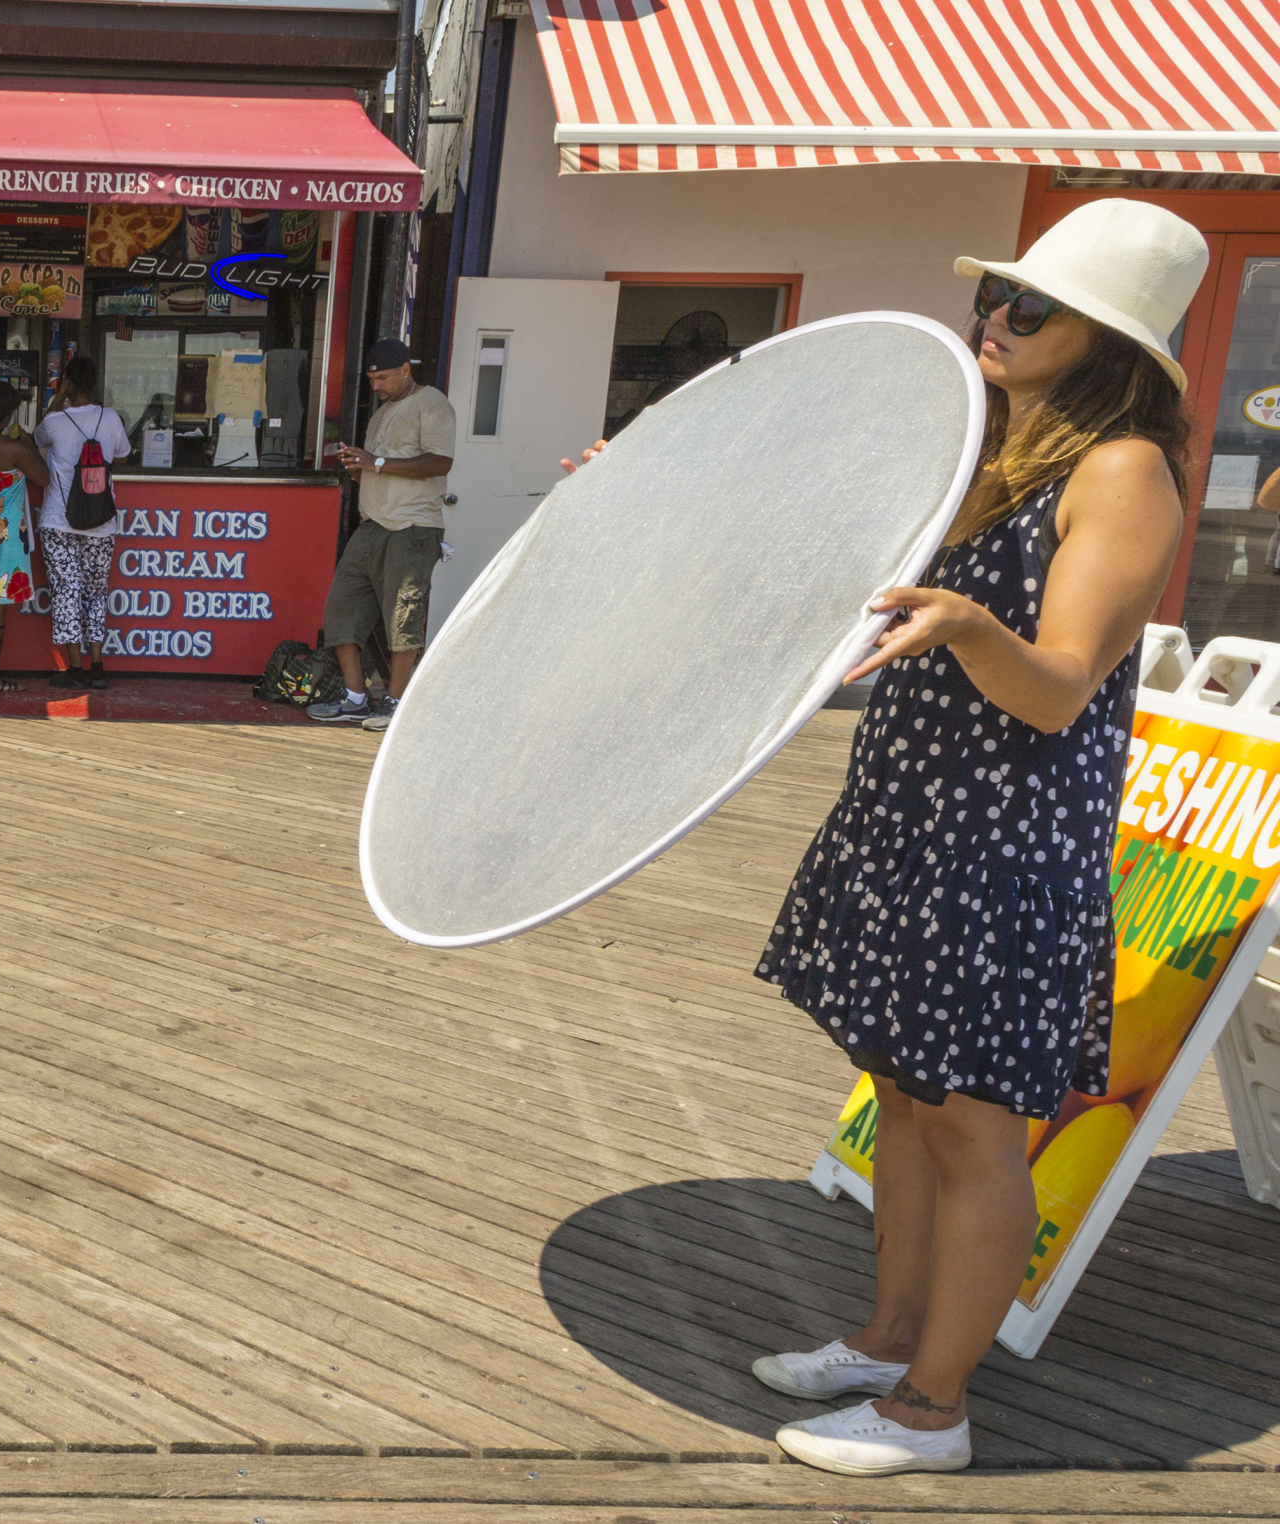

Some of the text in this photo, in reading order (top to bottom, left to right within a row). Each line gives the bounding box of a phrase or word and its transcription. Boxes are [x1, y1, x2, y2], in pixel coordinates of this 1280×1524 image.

[84, 171, 150, 195] FRIES
[175, 175, 282, 201] CHICKEN
[305, 180, 404, 204] NACHOS
[16, 216, 59, 225] DESSERTS
[128, 256, 331, 290] BUD LIGHT
[0, 296, 62, 315] Cones
[223, 384, 249, 396] ICE
[192, 510, 268, 539] ICES
[119, 549, 245, 579] CREAM
[107, 590, 171, 617] OLD
[183, 591, 273, 620] BEER
[81, 629, 212, 657] ACHOS
[1110, 833, 1261, 981] EMONADE
